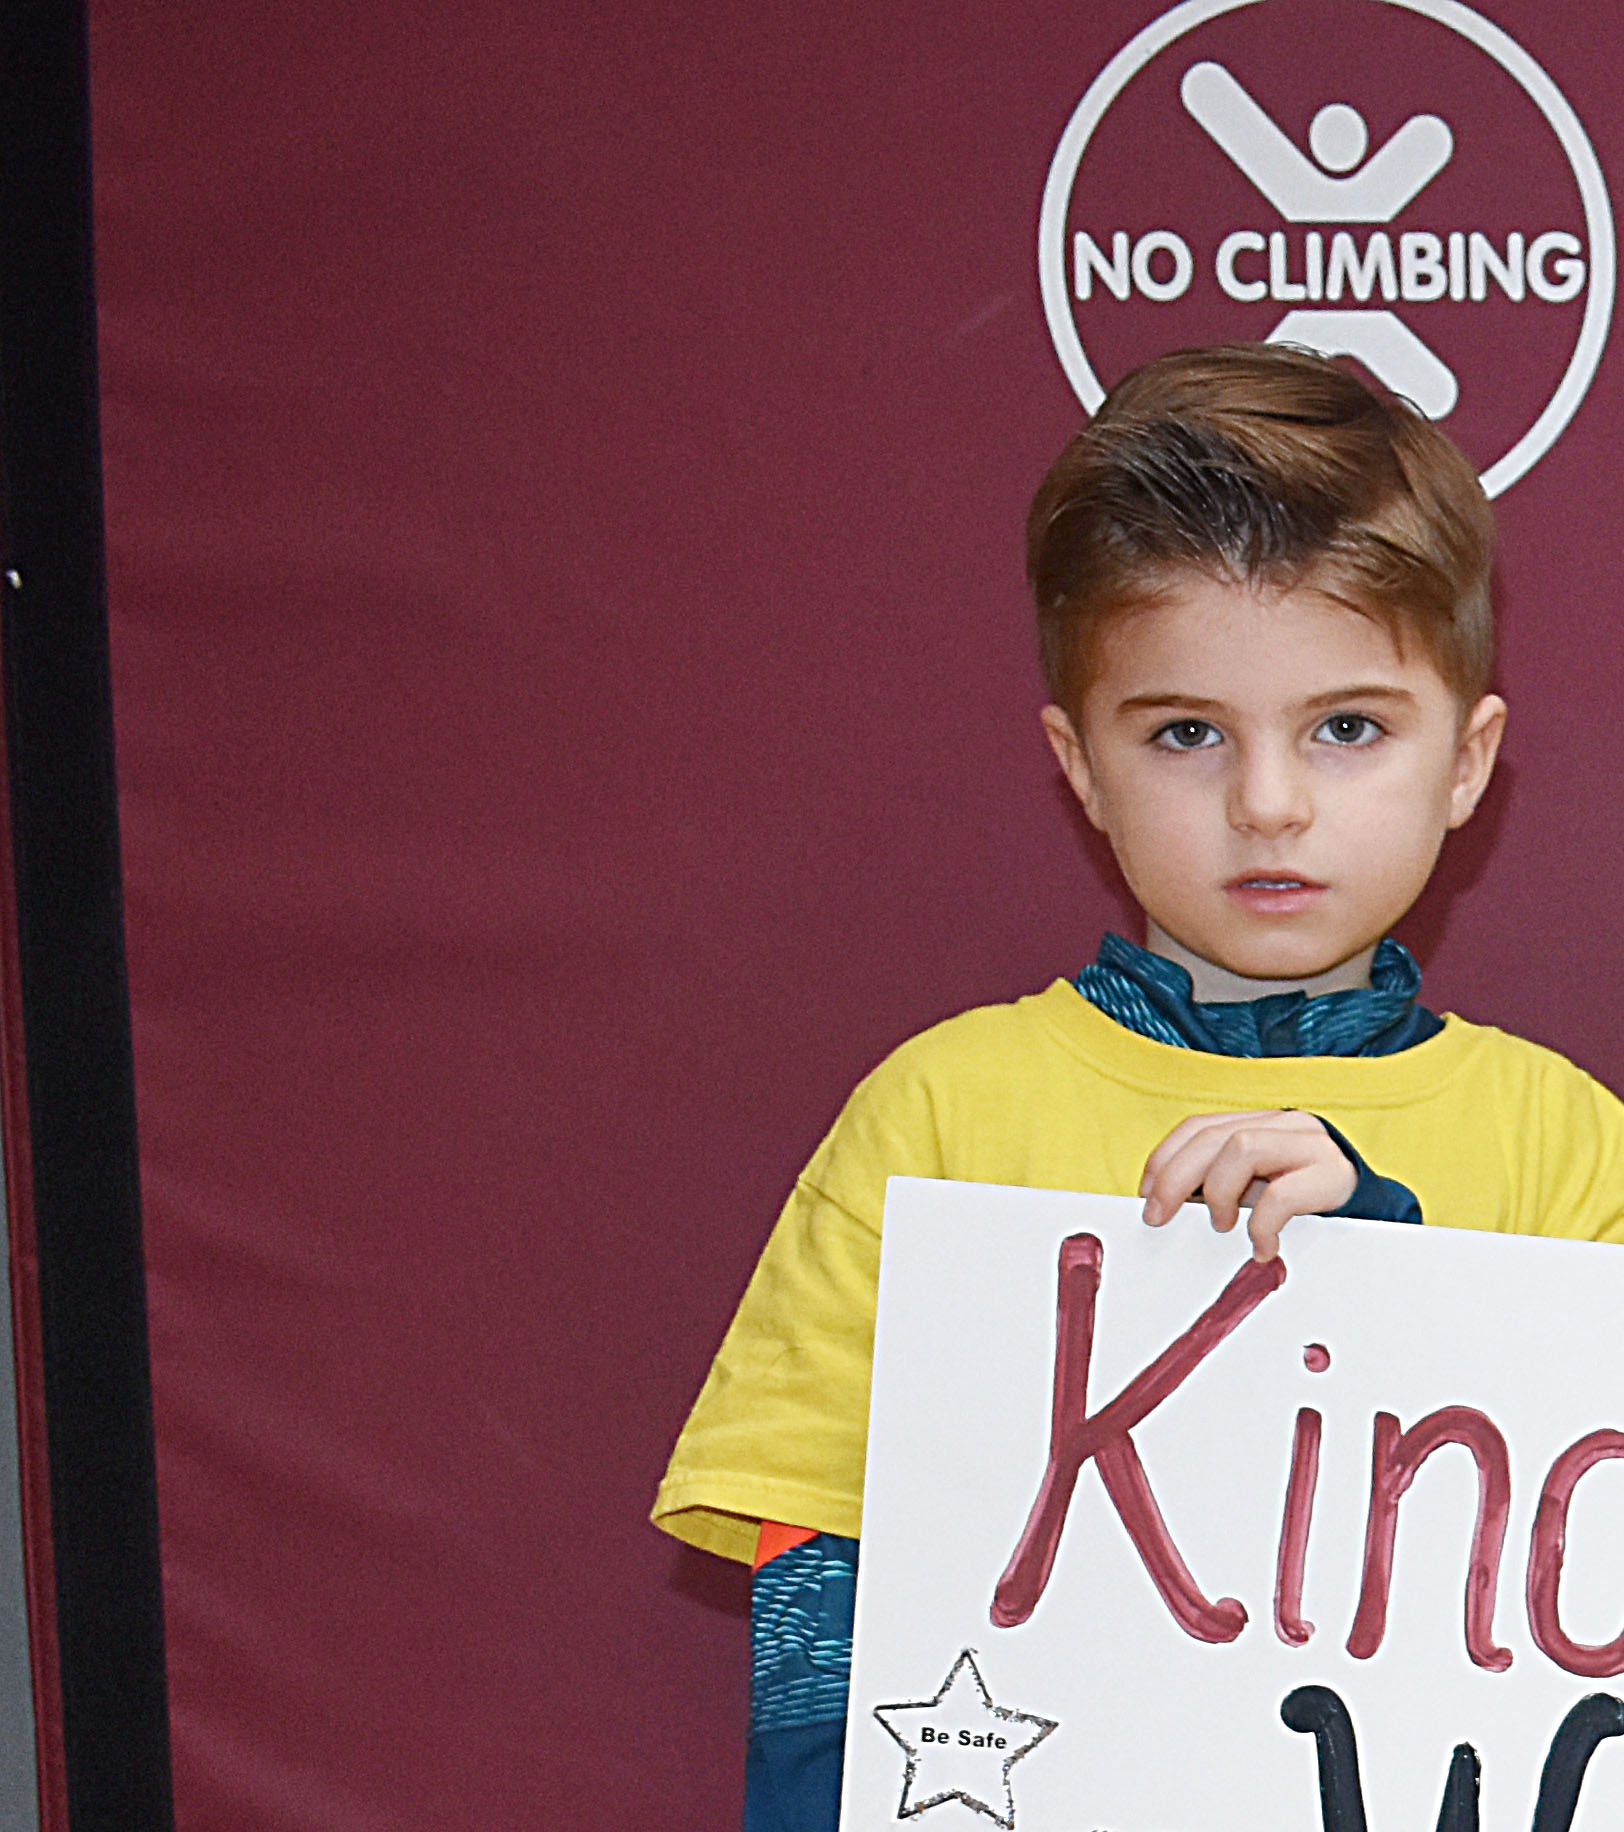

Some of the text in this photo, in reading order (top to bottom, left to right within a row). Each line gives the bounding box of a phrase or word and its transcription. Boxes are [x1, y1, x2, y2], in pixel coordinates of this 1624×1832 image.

[1073, 231, 1586, 302] NO CLIMBING
[921, 1726, 1007, 1750] Be Safe
